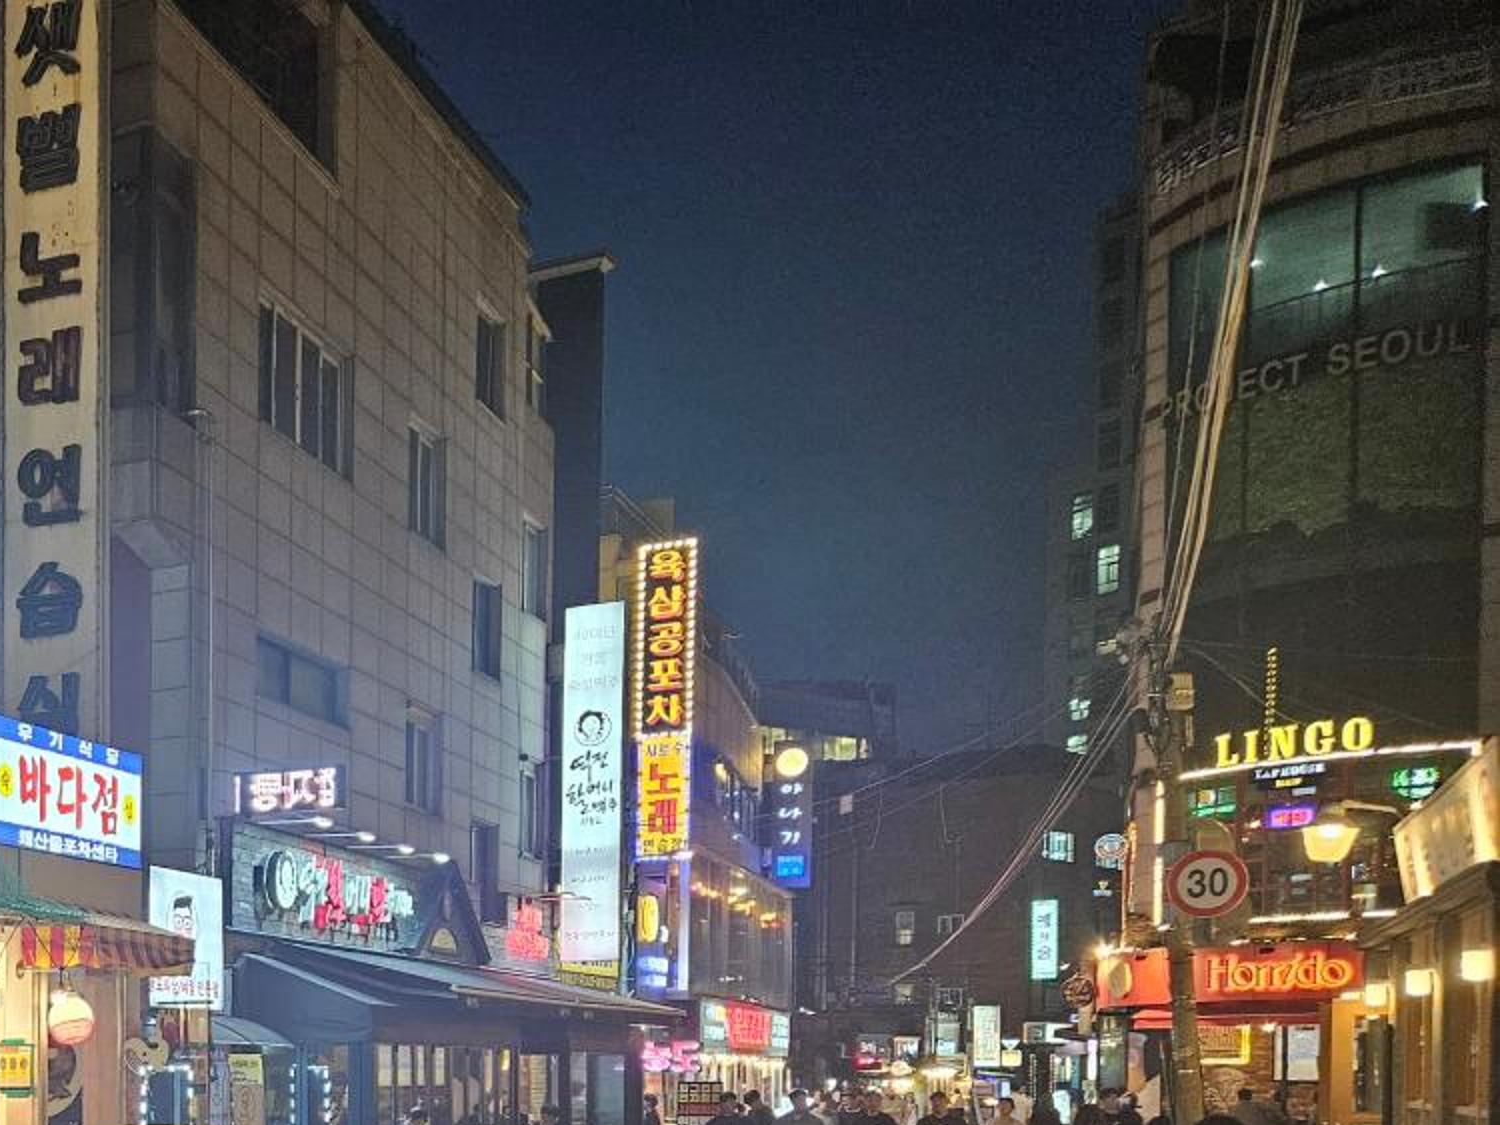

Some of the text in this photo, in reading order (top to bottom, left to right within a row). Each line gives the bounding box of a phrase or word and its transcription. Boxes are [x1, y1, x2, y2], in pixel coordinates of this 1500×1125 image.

[1152, 320, 1471, 421] PROECT SEOUL
[17, 722, 120, 765] 우기식당
[1214, 717, 1374, 768] LINGO
[18, 754, 119, 836] 바다점
[646, 763, 681, 834] 노래
[1187, 868, 1228, 899] 30
